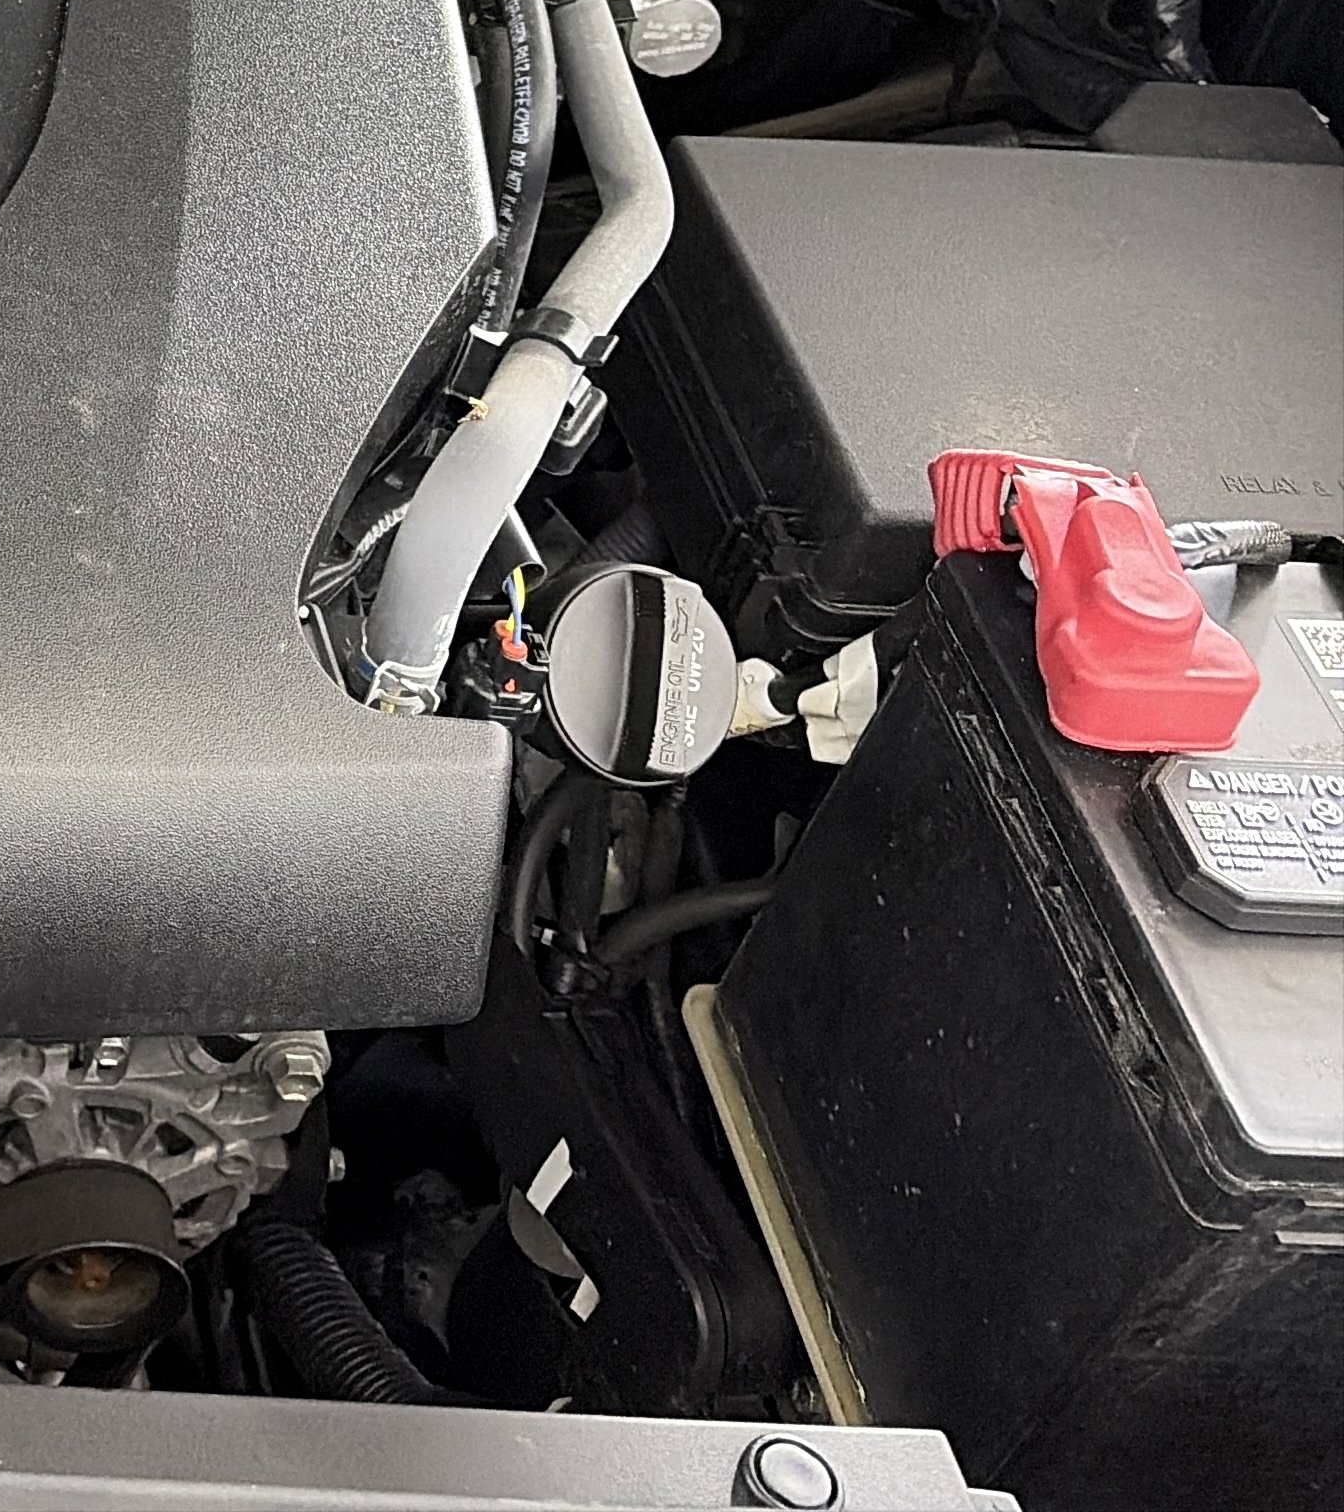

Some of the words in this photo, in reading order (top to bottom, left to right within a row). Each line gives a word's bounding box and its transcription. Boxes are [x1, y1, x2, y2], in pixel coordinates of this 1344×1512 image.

[504, 170, 523, 193] NOT
[1220, 474, 1301, 496] RELAY
[666, 654, 685, 686] OIL
[659, 687, 682, 767] ENGINE
[1210, 770, 1298, 795] DANGER
